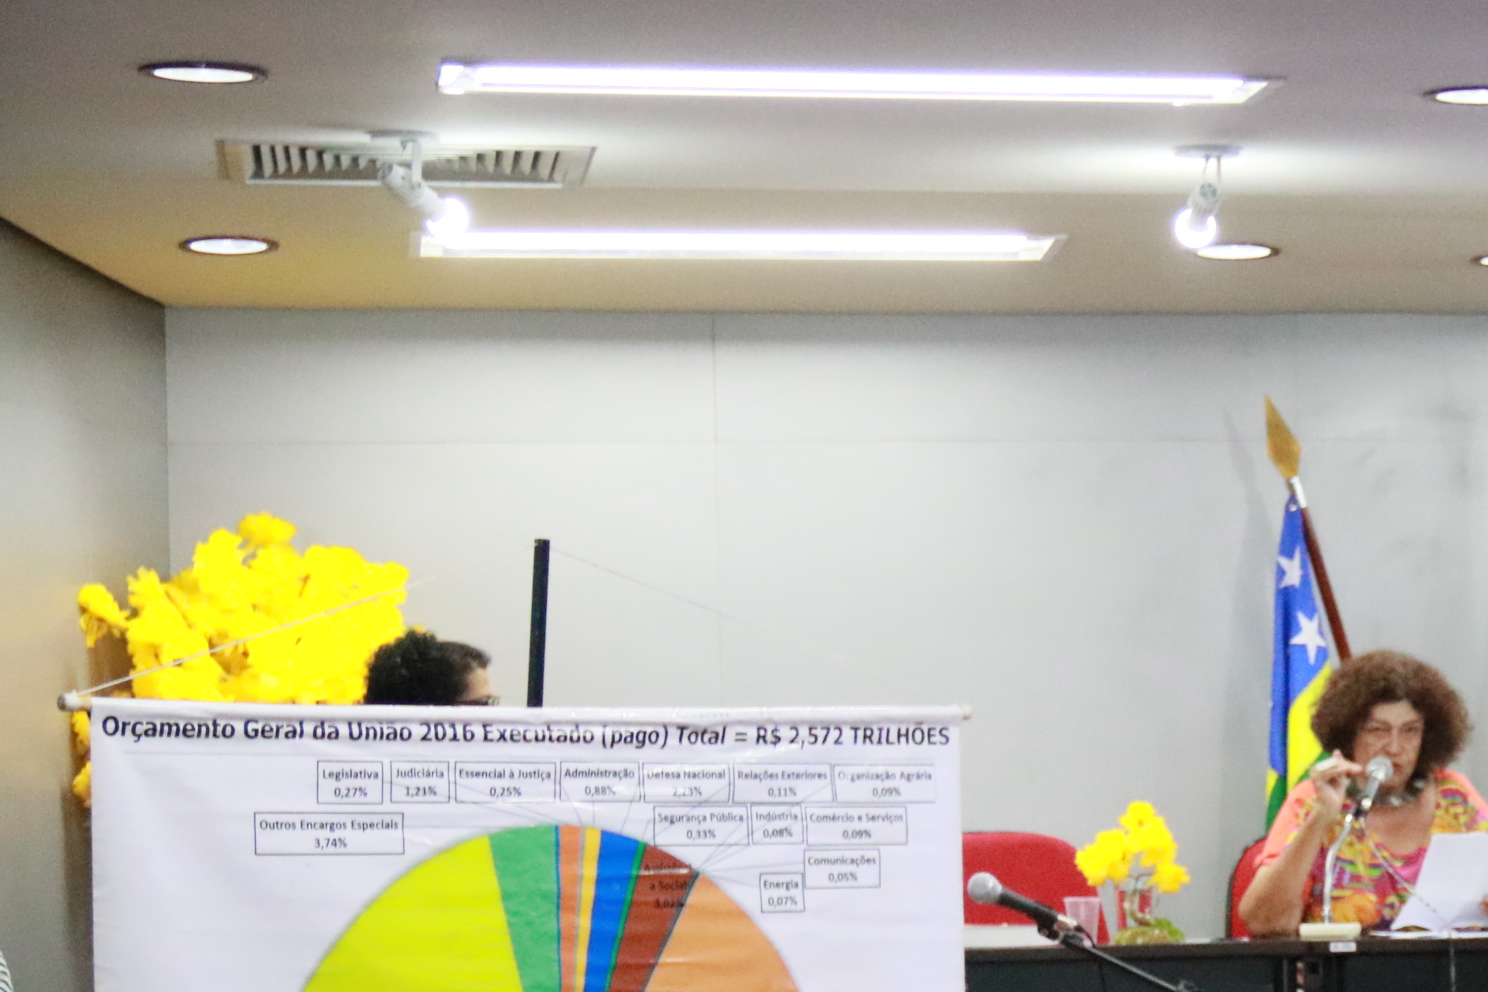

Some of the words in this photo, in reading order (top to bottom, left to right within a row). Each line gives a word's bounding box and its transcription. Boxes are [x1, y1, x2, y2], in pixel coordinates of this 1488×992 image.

[102, 716, 236, 742] Orçamento
[244, 719, 304, 740] Geral
[312, 720, 340, 741] da
[348, 721, 412, 742] União
[420, 723, 475, 742] 2016
[482, 723, 594, 743] Executado
[602, 725, 669, 749] (pago)
[677, 725, 726, 746] Total
[734, 732, 748, 742] =
[756, 725, 781, 748] R$
[789, 726, 843, 747] 2,572
[851, 722, 949, 746] TRILHÕES
[322, 768, 379, 781] Legislativa
[396, 768, 444, 779] Judiciária
[459, 768, 506, 779] Essencial
[518, 769, 552, 782] Justiça
[564, 767, 635, 782] Administração
[684, 769, 726, 780] Nacional
[738, 770, 778, 783] Relações
[781, 770, 827, 781] Exteriores
[900, 770, 932, 783] Agrária
[334, 787, 368, 799] 0,27%
[405, 786, 437, 798] 1,21%
[489, 786, 522, 798] 0,25%
[585, 786, 616, 797] 0,88%
[768, 787, 797, 798] 0,11%
[872, 787, 901, 798] 0,09%
[658, 812, 707, 825] Segurança
[710, 812, 744, 823] Pública
[755, 811, 798, 822] Indústria
[810, 812, 855, 823] Comércio
[866, 812, 904, 826] Serviços
[259, 819, 297, 832] Outros
[300, 819, 347, 832] Encargos
[351, 819, 398, 832] Especiais
[687, 829, 716, 840] 0,33%
[763, 827, 793, 839] 0,08%
[843, 829, 872, 840] 0,09%
[314, 838, 347, 850] 3,74%
[808, 855, 877, 867] Comunicações
[828, 872, 858, 883] 0,05%
[763, 880, 799, 892] Energia
[768, 896, 797, 907] 0,07%
